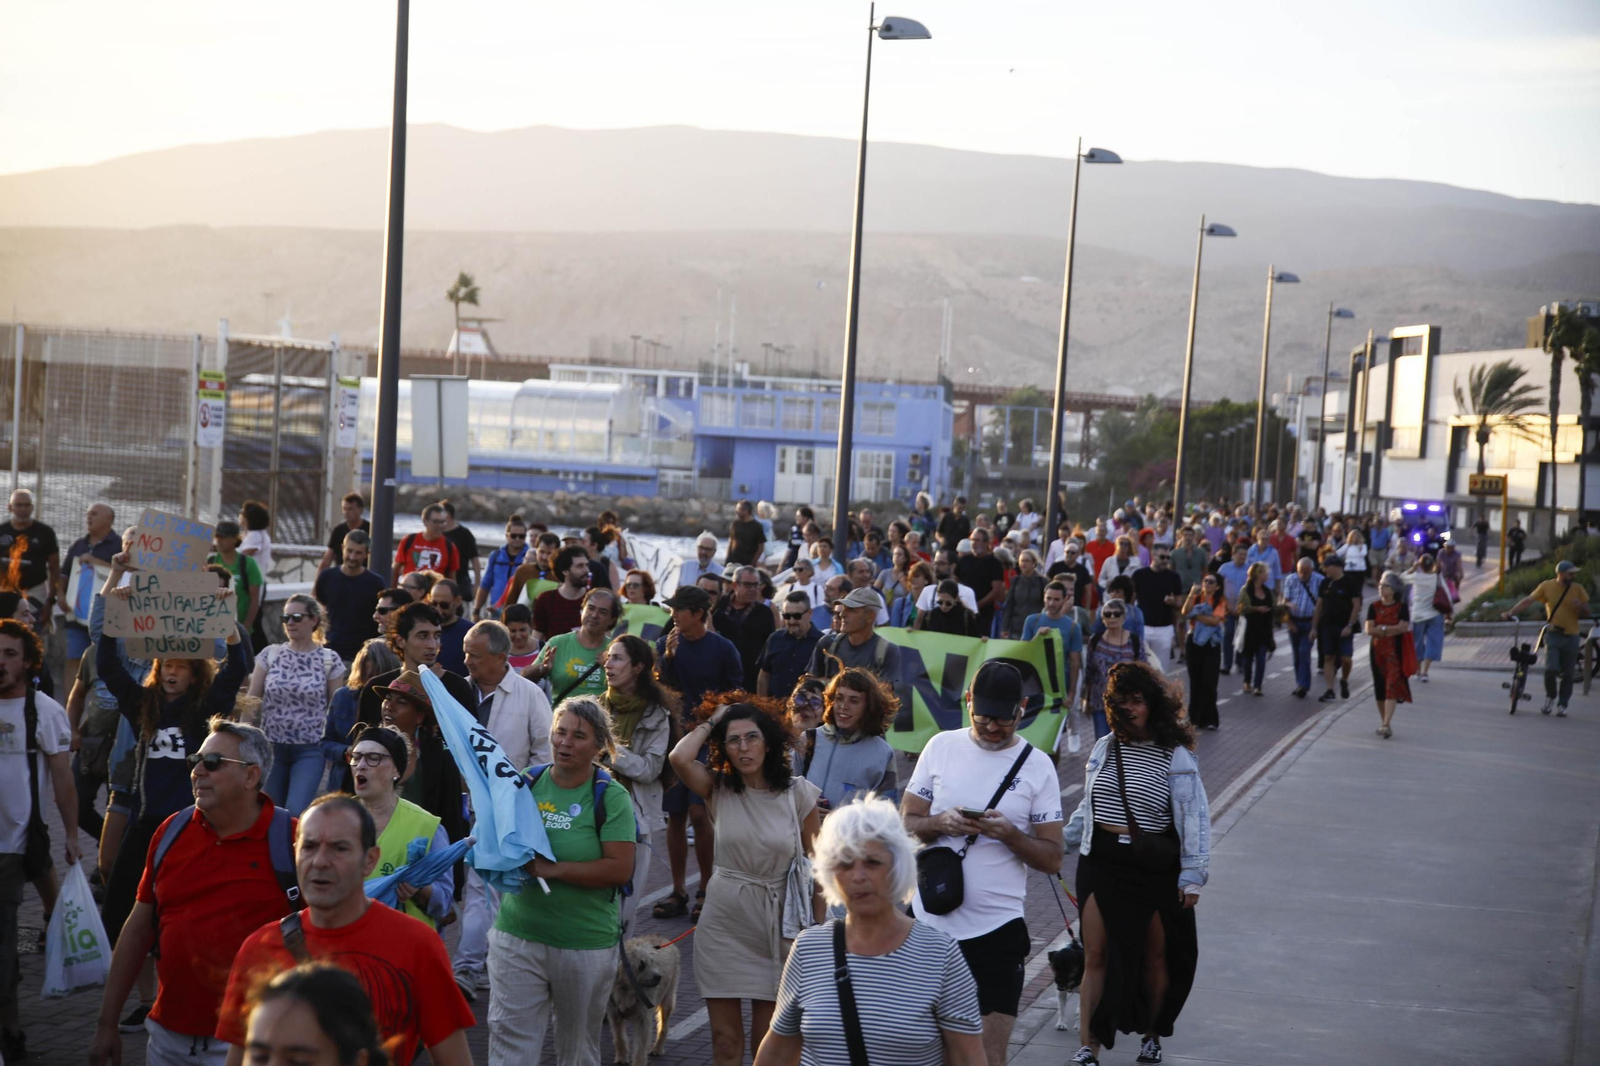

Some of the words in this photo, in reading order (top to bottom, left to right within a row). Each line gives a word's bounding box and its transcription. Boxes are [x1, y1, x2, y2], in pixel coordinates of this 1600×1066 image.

[144, 512, 167, 531] LA
[137, 533, 163, 552] NO
[168, 541, 191, 560] SE
[136, 574, 159, 593] LA
[128, 591, 231, 617] NATURALEZA
[133, 615, 155, 633] NO
[159, 615, 206, 634] TIENE
[545, 820, 572, 830] EQUO
